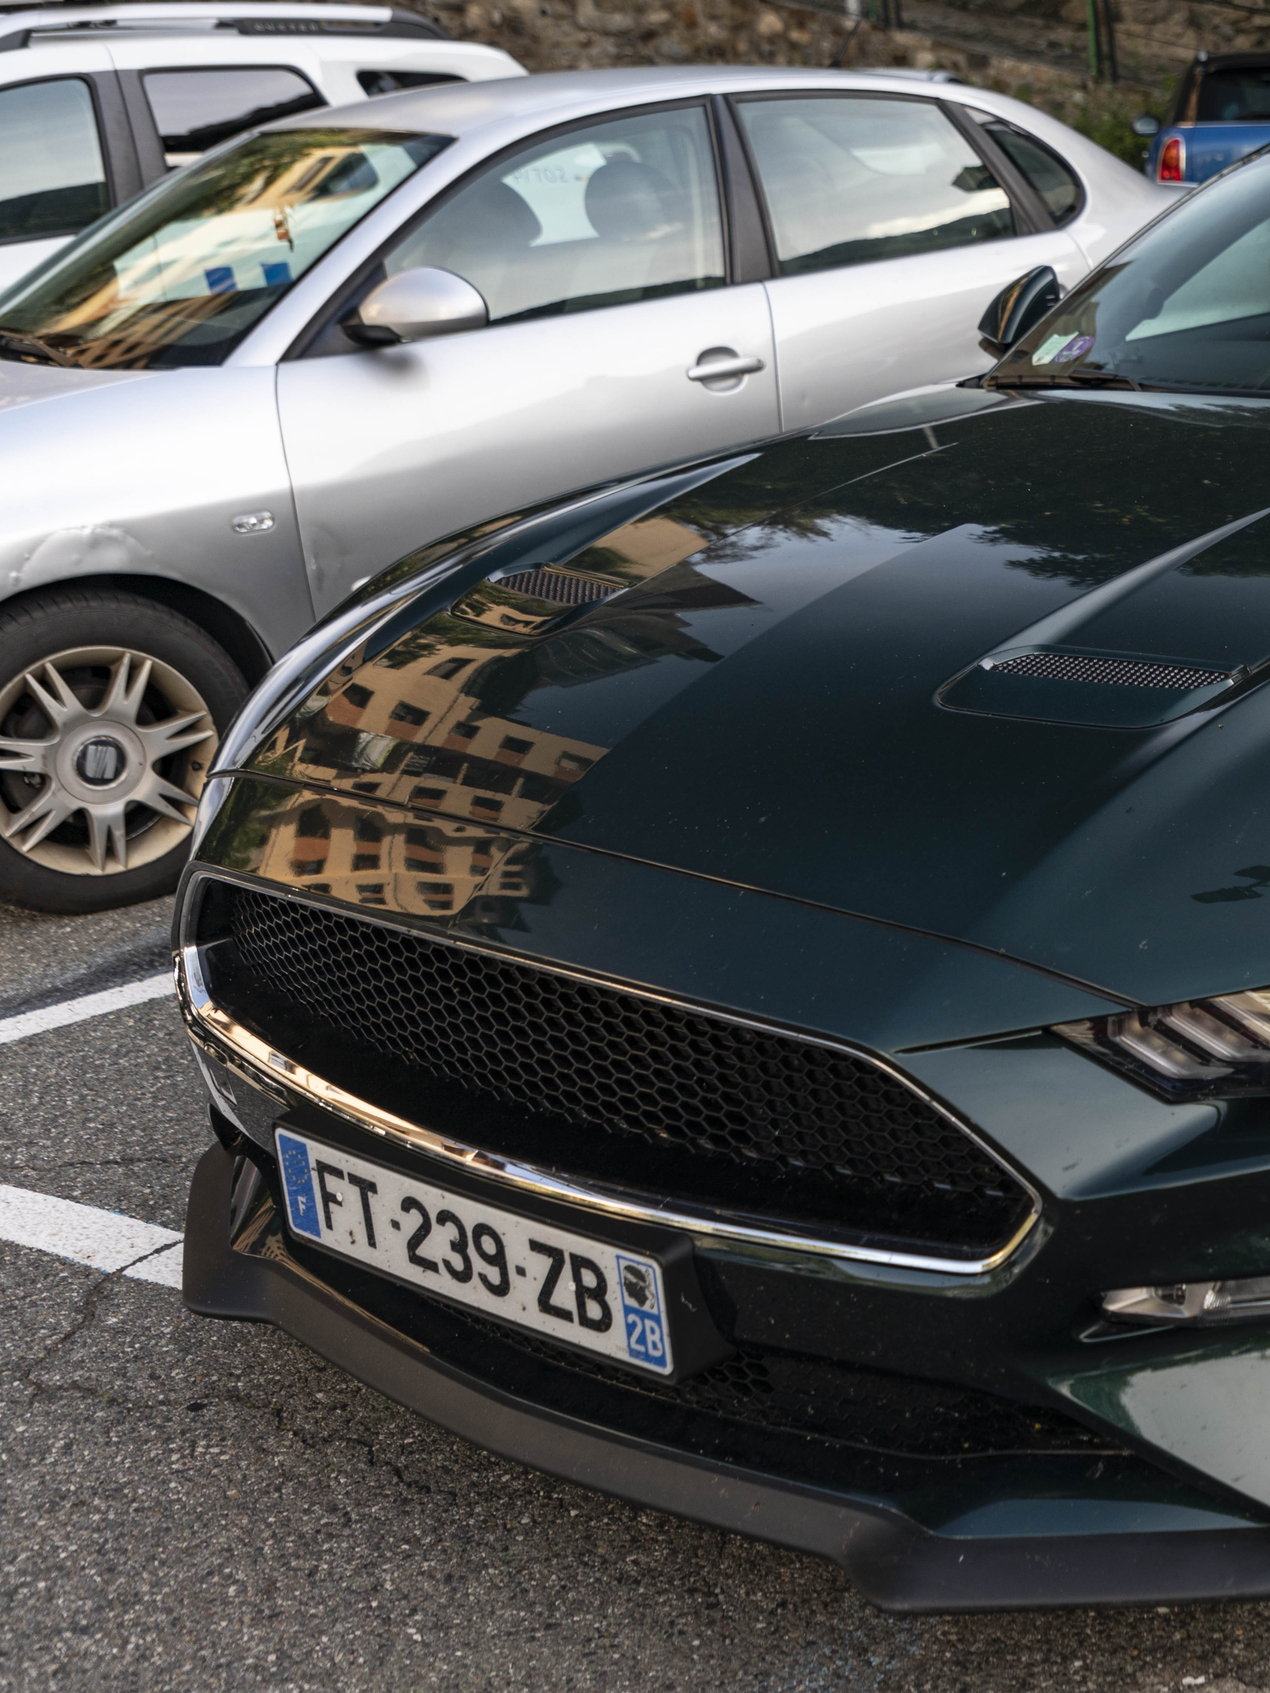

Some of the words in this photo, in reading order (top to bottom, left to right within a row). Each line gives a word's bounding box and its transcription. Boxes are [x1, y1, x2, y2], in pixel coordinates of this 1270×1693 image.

[297, 1195, 307, 1216] F
[315, 1159, 613, 1333] FT-239-ZB
[627, 1313, 663, 1358] 2B
